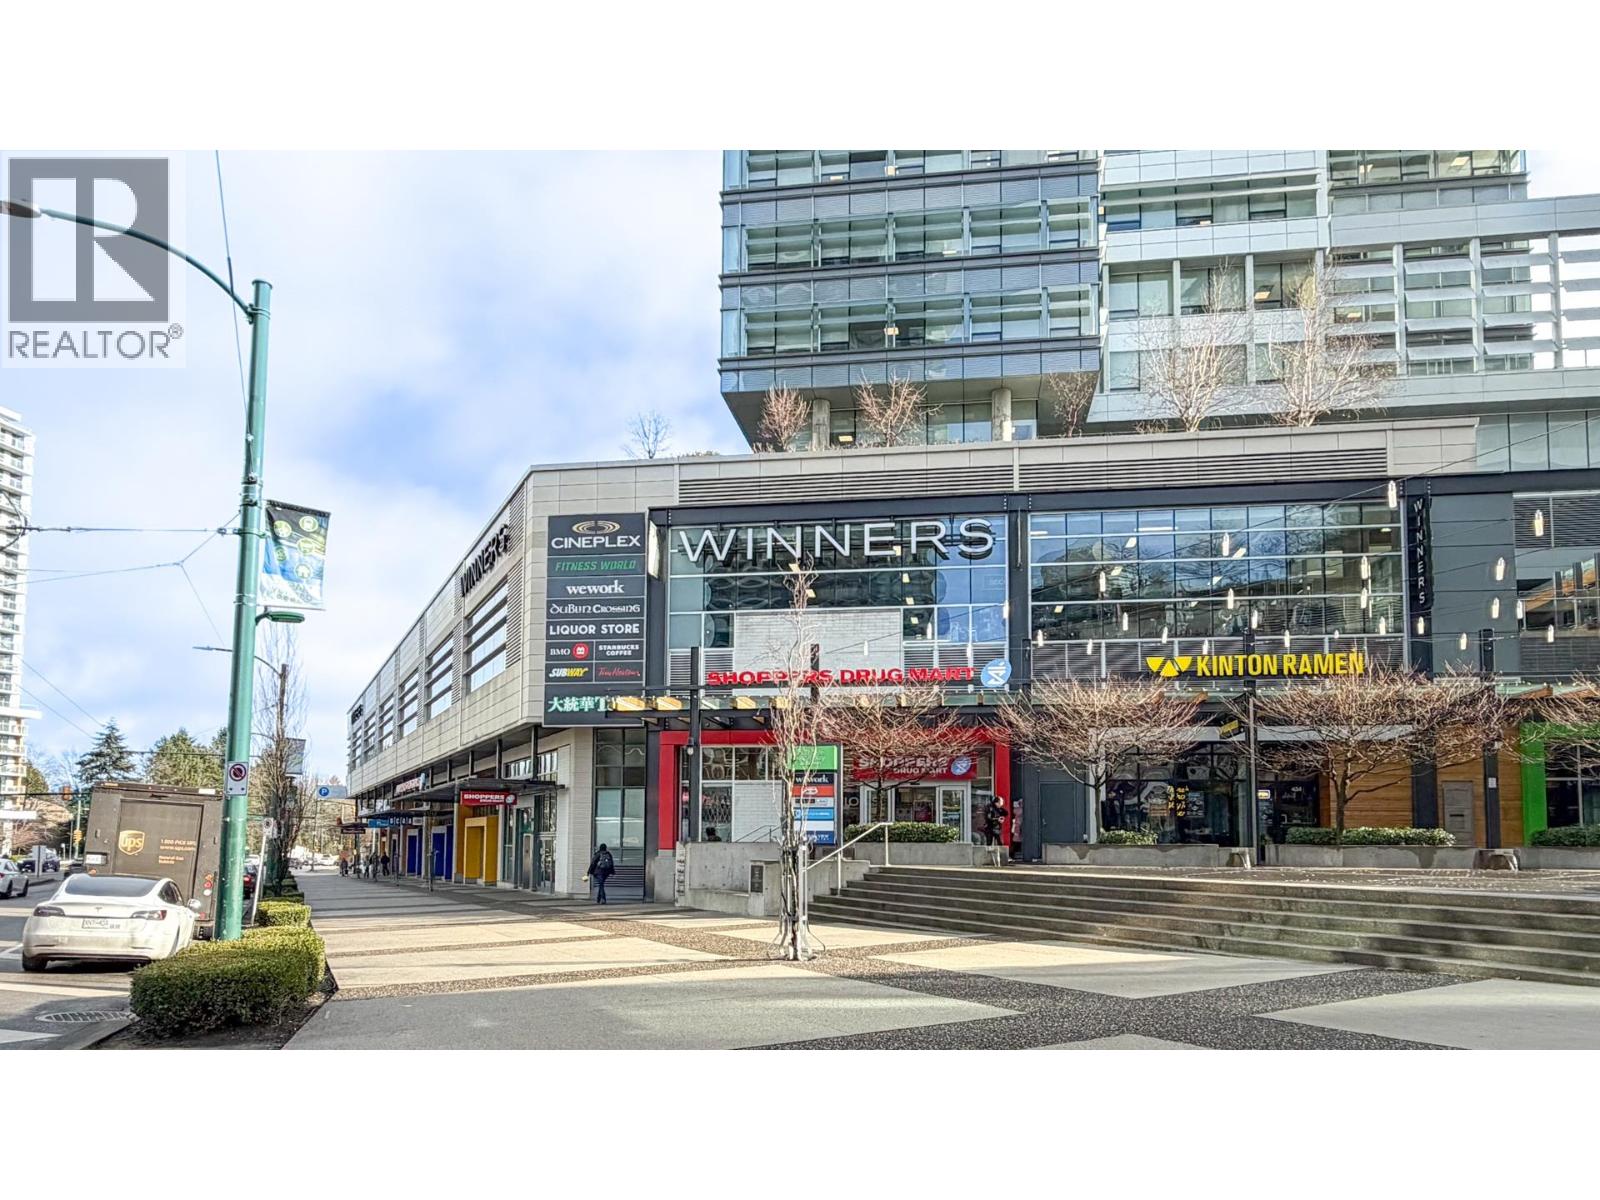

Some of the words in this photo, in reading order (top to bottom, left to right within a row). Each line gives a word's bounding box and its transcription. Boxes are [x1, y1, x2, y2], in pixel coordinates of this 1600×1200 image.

[551, 535, 641, 549] CINEPLEX
[679, 518, 994, 562] WINNERS
[1414, 498, 1426, 604] WINNERS
[555, 561, 598, 571] FITNESS
[600, 560, 637, 570] WORLD
[566, 580, 625, 594] wework
[549, 624, 596, 635] LIQUOR
[601, 623, 640, 634] STORE
[550, 648, 571, 656] BMO
[1196, 654, 1278, 676] KINTON
[1283, 652, 1364, 675] RAMEN
[549, 667, 588, 678] SUBWAY
[839, 668, 903, 684] DRUG
[908, 667, 976, 681] MART
